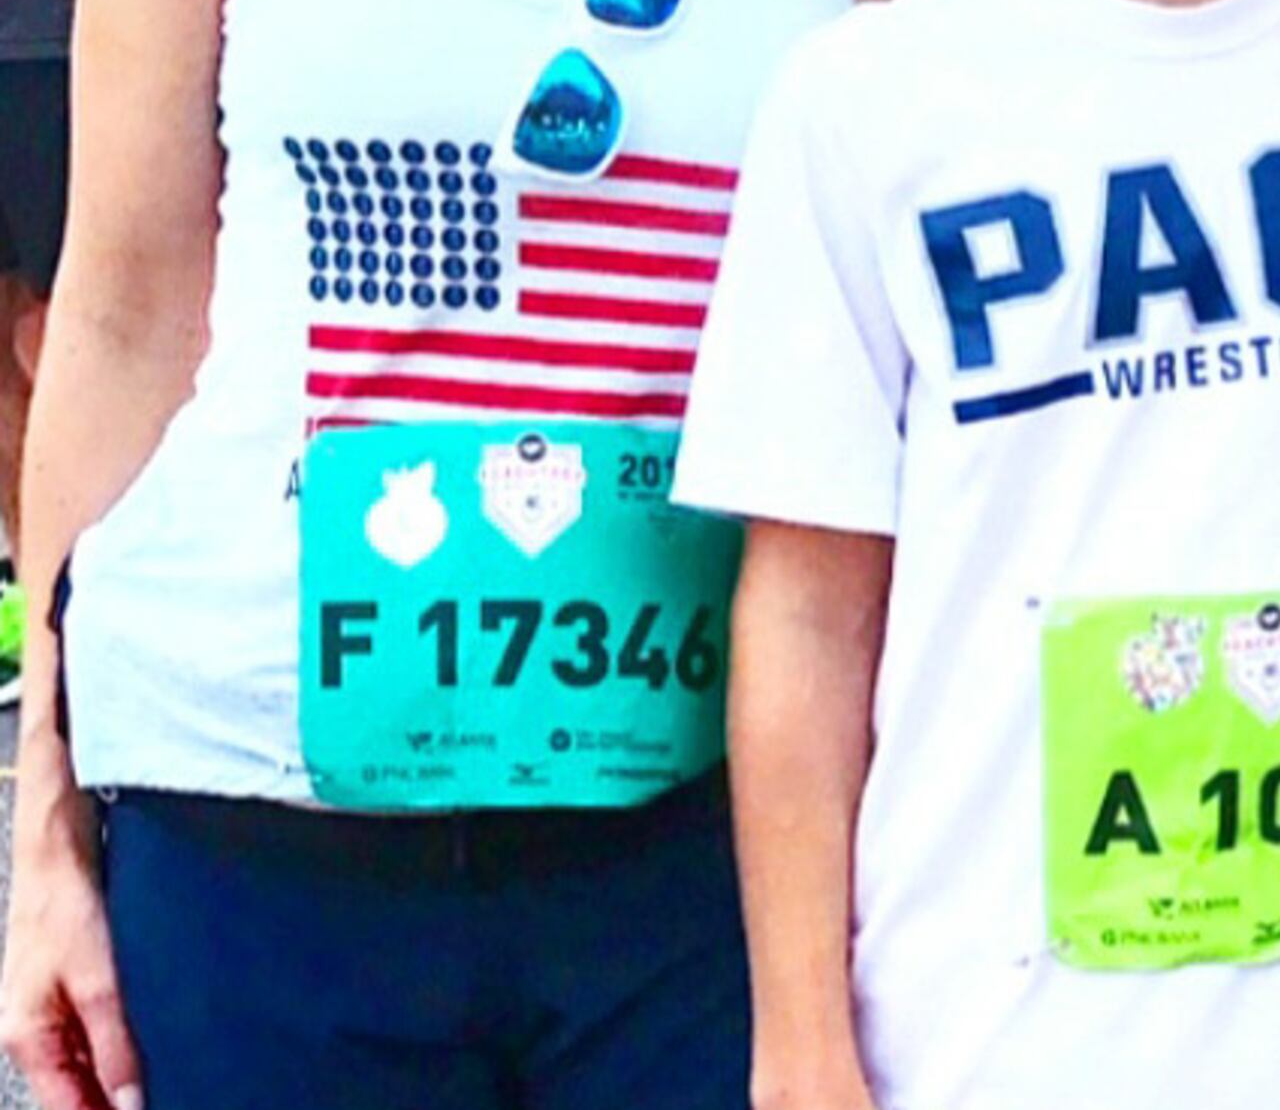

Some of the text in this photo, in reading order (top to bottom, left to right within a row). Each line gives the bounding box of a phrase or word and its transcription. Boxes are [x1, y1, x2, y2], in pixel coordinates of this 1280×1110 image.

[618, 454, 675, 488] 20
[319, 600, 720, 693] F 17346
[1083, 769, 1162, 856] A
